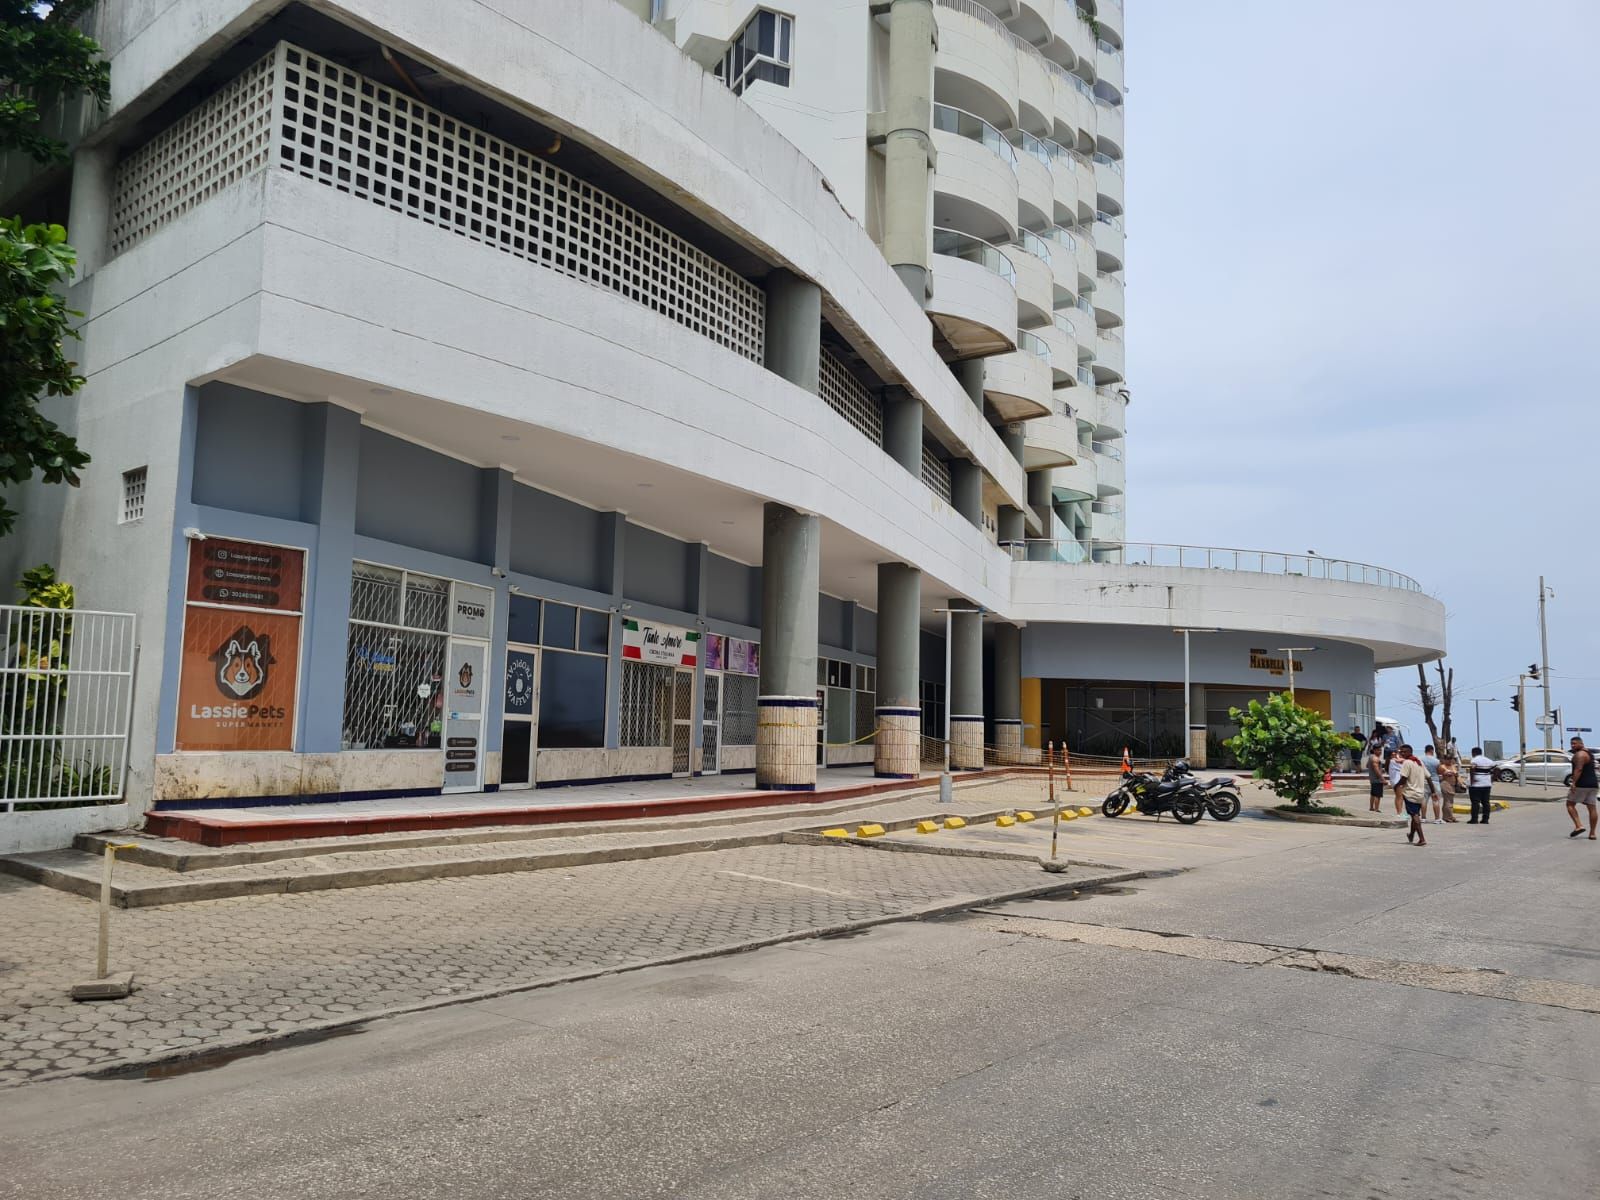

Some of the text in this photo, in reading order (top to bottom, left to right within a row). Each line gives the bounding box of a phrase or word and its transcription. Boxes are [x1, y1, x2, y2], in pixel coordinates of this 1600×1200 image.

[506, 659, 532, 680] TROPICAL
[507, 686, 532, 706] WAFFLES
[191, 702, 285, 719] LassiePets
